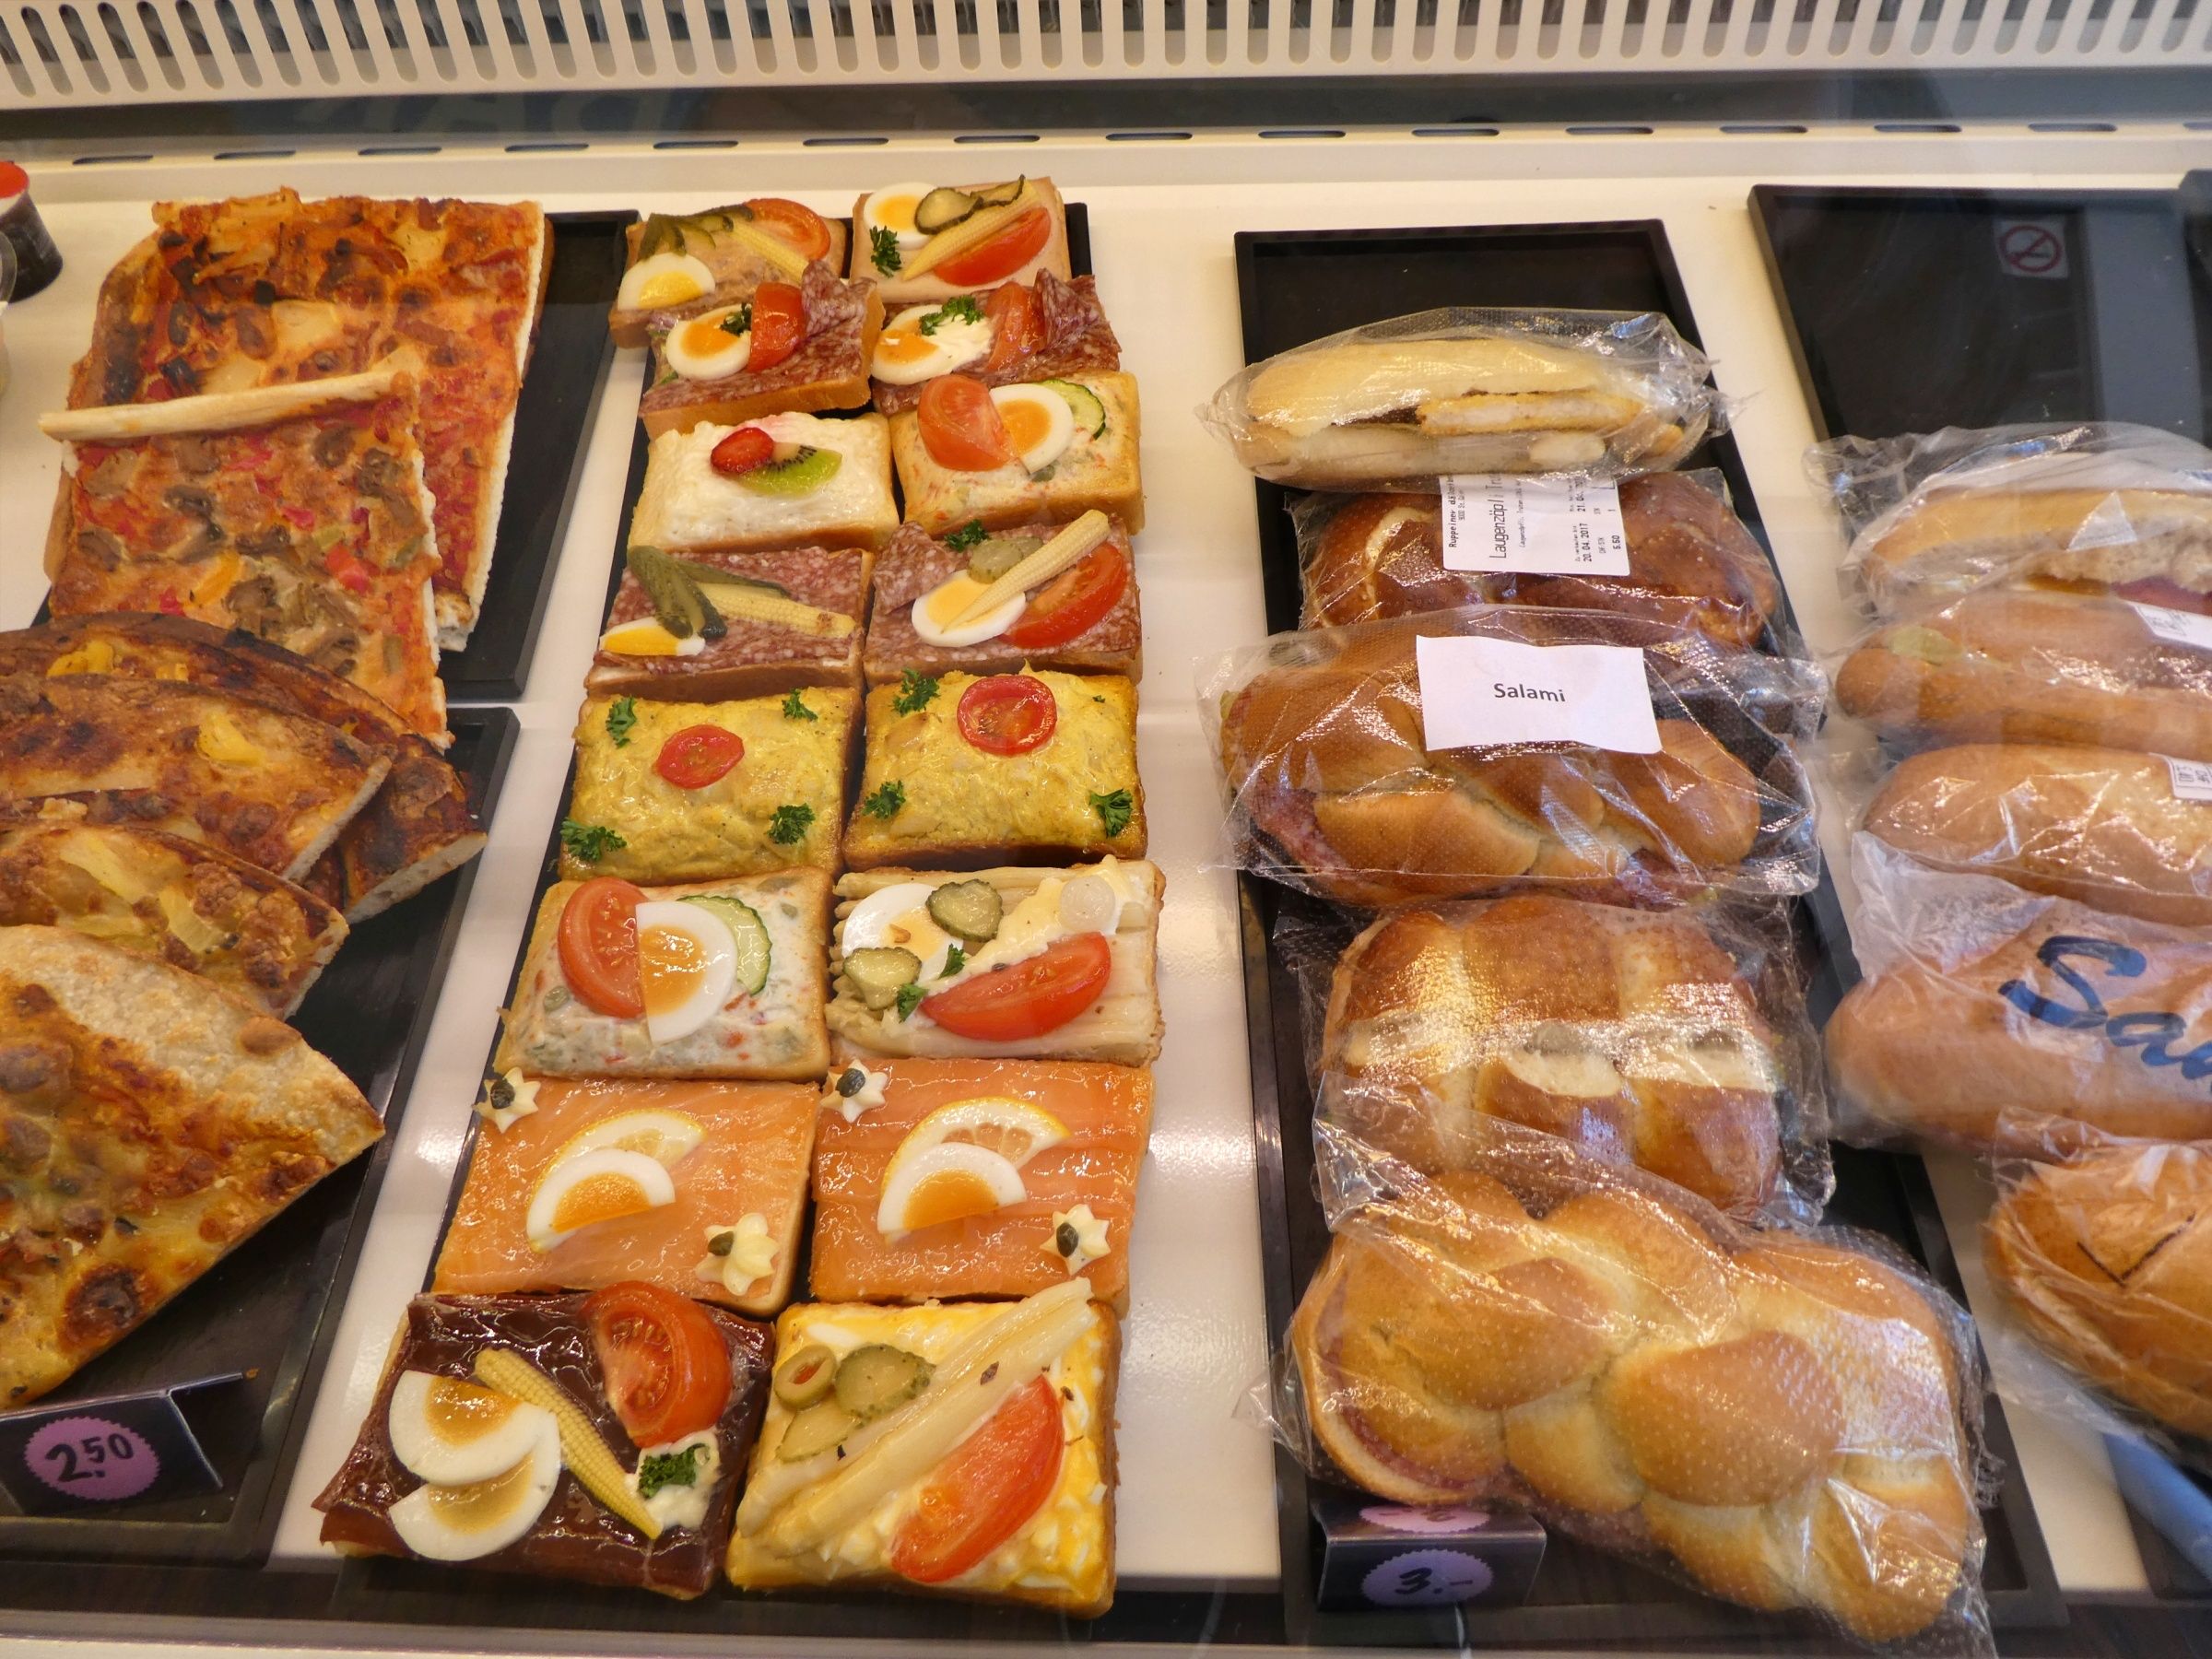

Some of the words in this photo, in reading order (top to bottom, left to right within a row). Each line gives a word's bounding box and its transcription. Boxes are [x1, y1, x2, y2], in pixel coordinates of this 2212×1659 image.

[1448, 510, 1459, 547] Ruppeiner
[1611, 535, 1621, 550] 5.50
[1493, 683, 1566, 702] Salami
[45, 1432, 135, 1483] 2.50
